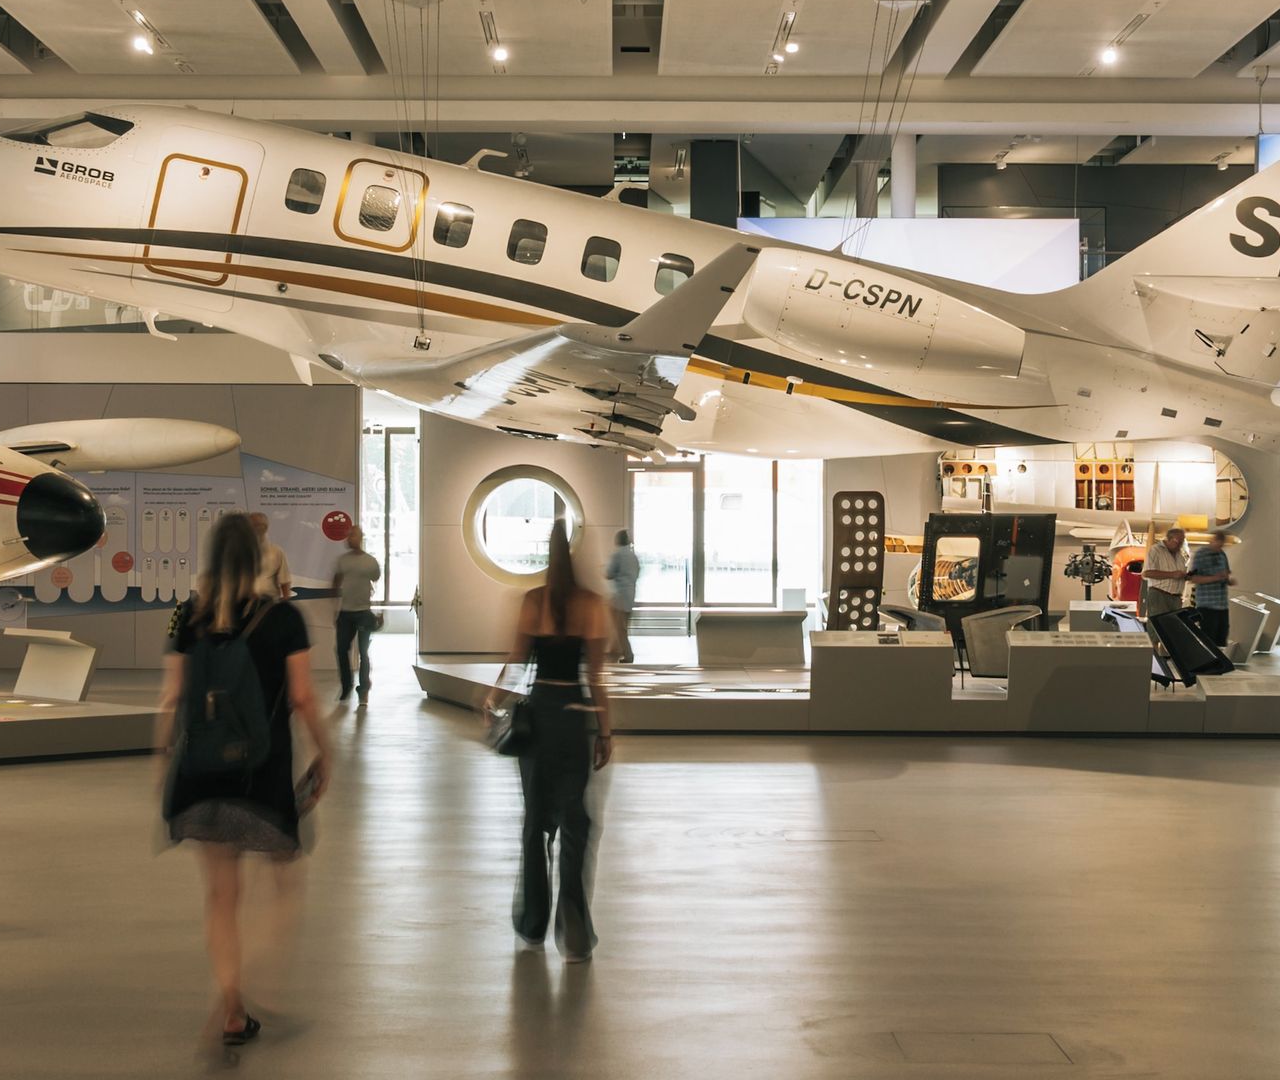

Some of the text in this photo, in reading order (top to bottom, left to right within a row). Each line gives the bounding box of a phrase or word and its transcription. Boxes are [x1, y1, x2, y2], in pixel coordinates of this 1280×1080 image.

[60, 172, 112, 189] AEROSPACE
[62, 162, 115, 181] GROB
[805, 269, 922, 318] D-CSPN
